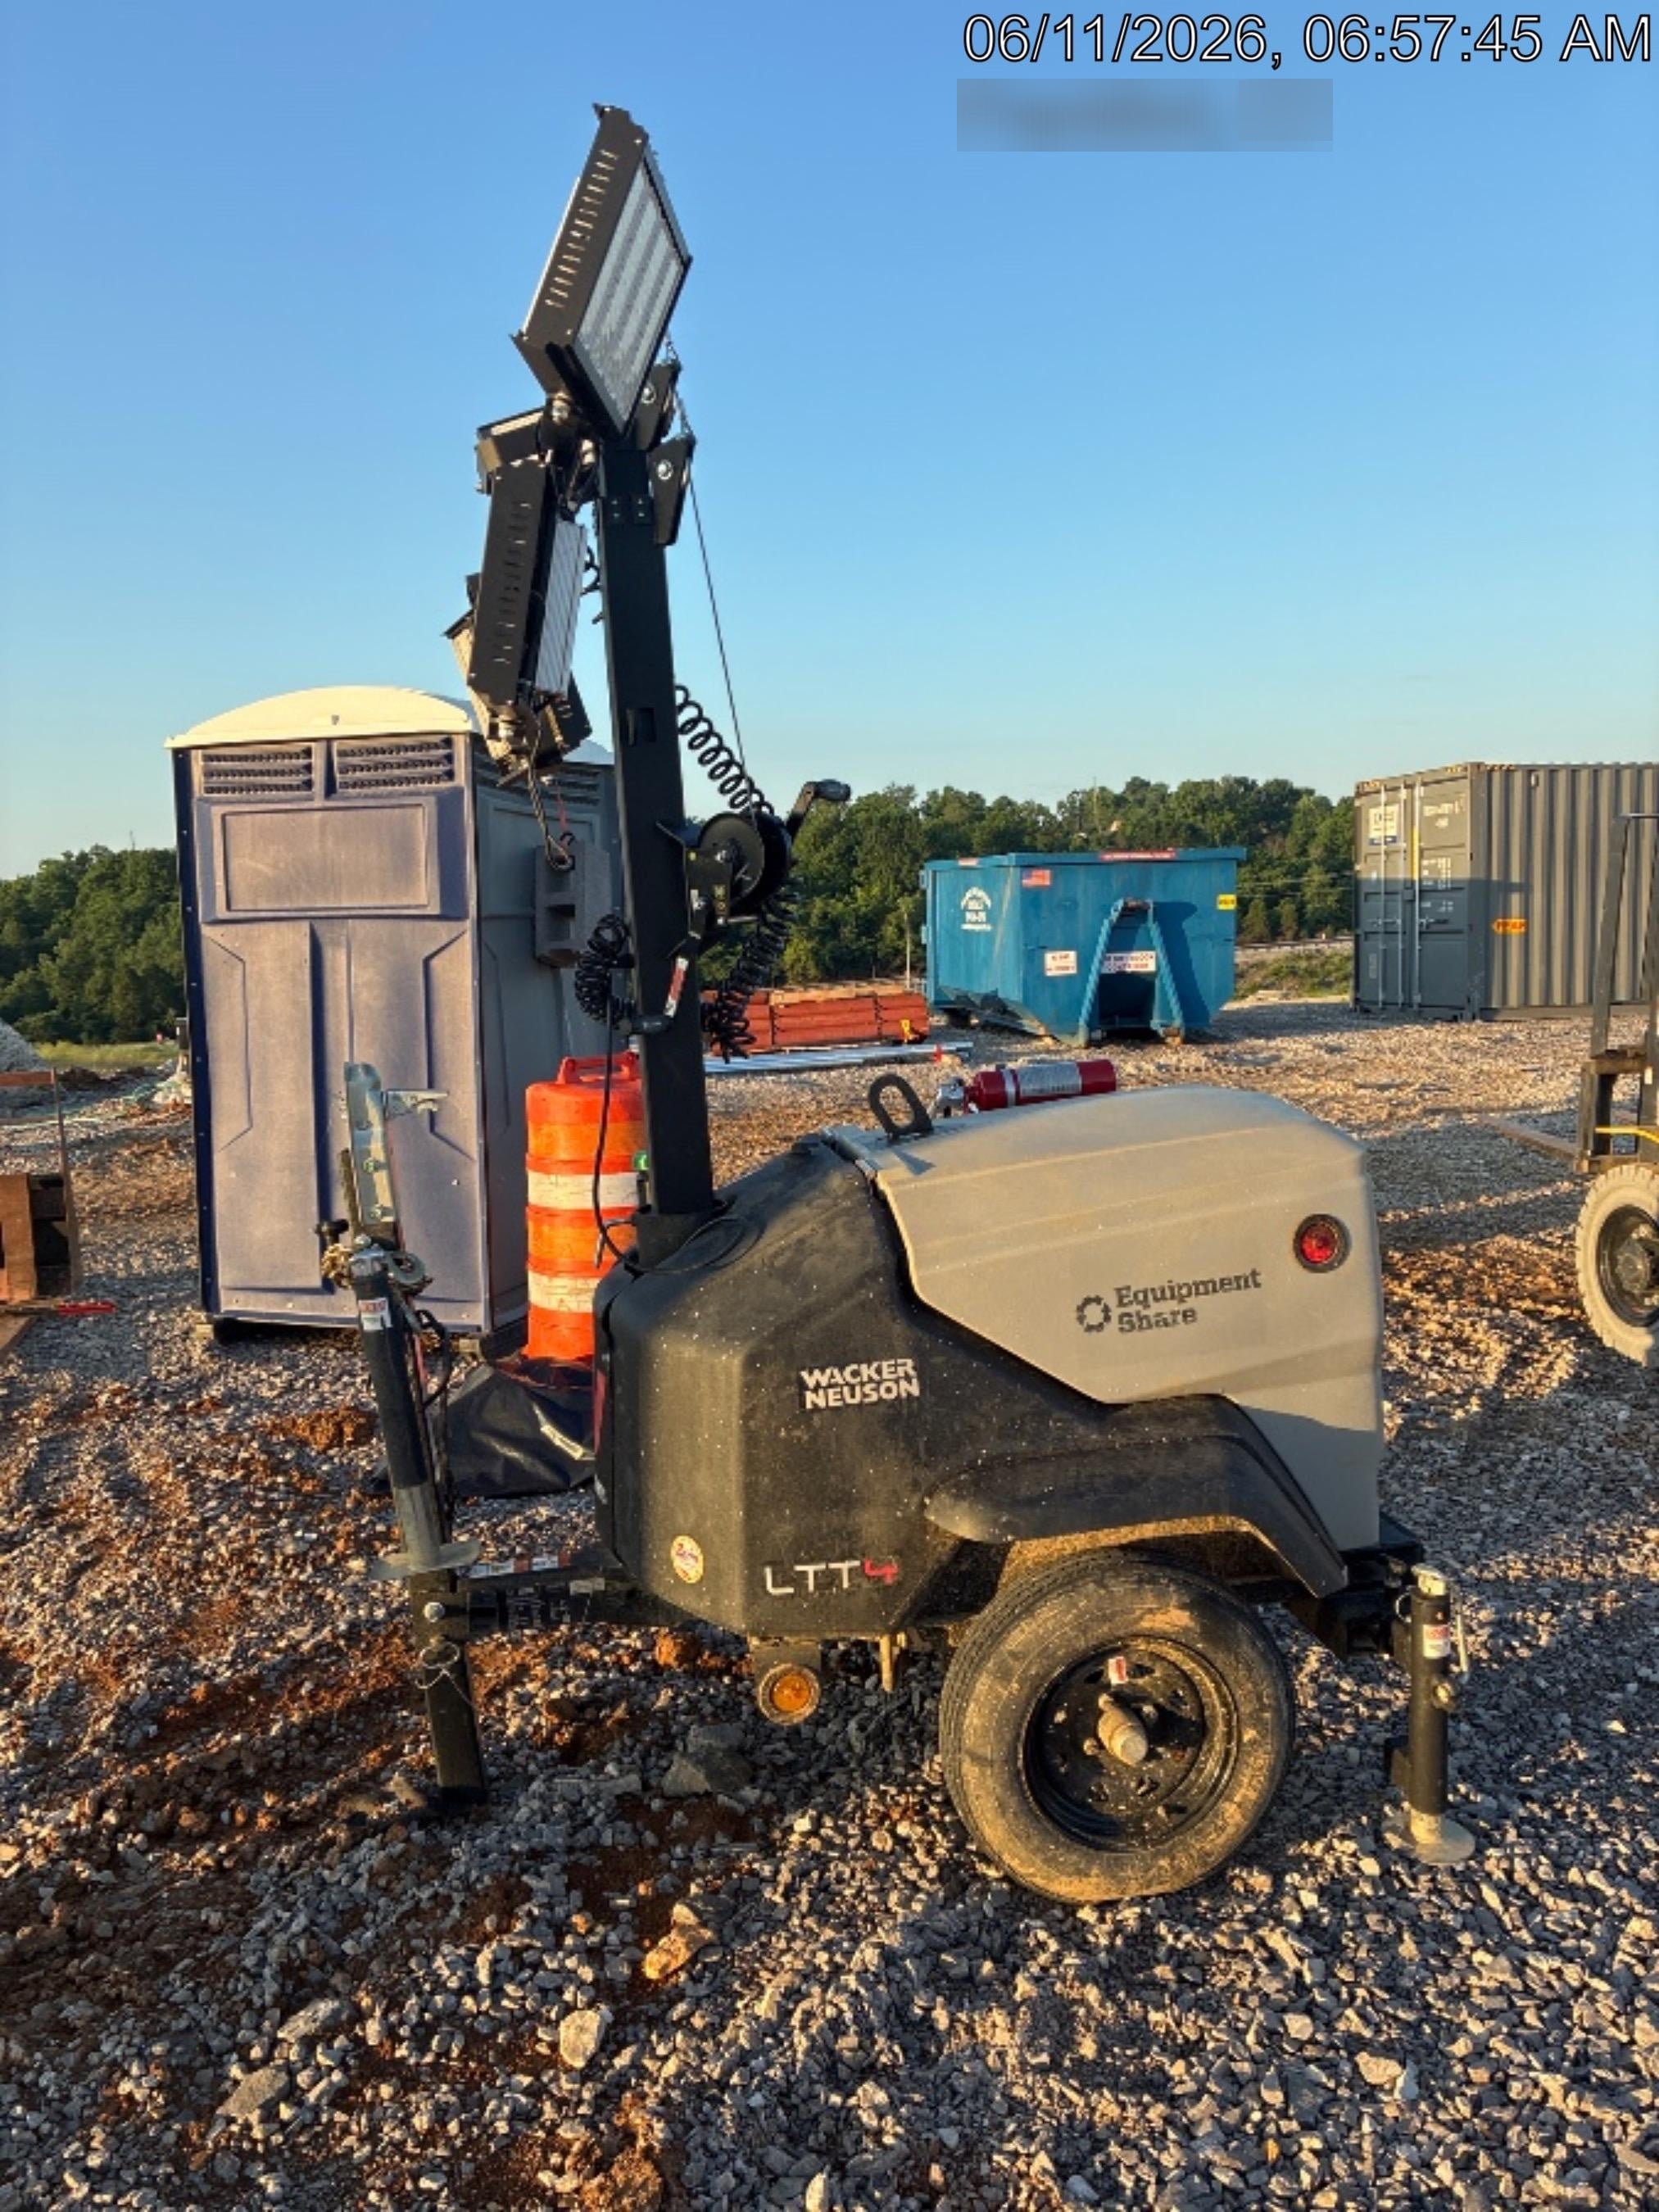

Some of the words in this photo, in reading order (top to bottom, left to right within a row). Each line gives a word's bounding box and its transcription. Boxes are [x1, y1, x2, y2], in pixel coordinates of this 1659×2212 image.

[1114, 1268, 1262, 1310] Equipment
[1117, 1308, 1198, 1334] Share
[800, 1358, 918, 1389] WACKER
[805, 1378, 921, 1410] NEUSON
